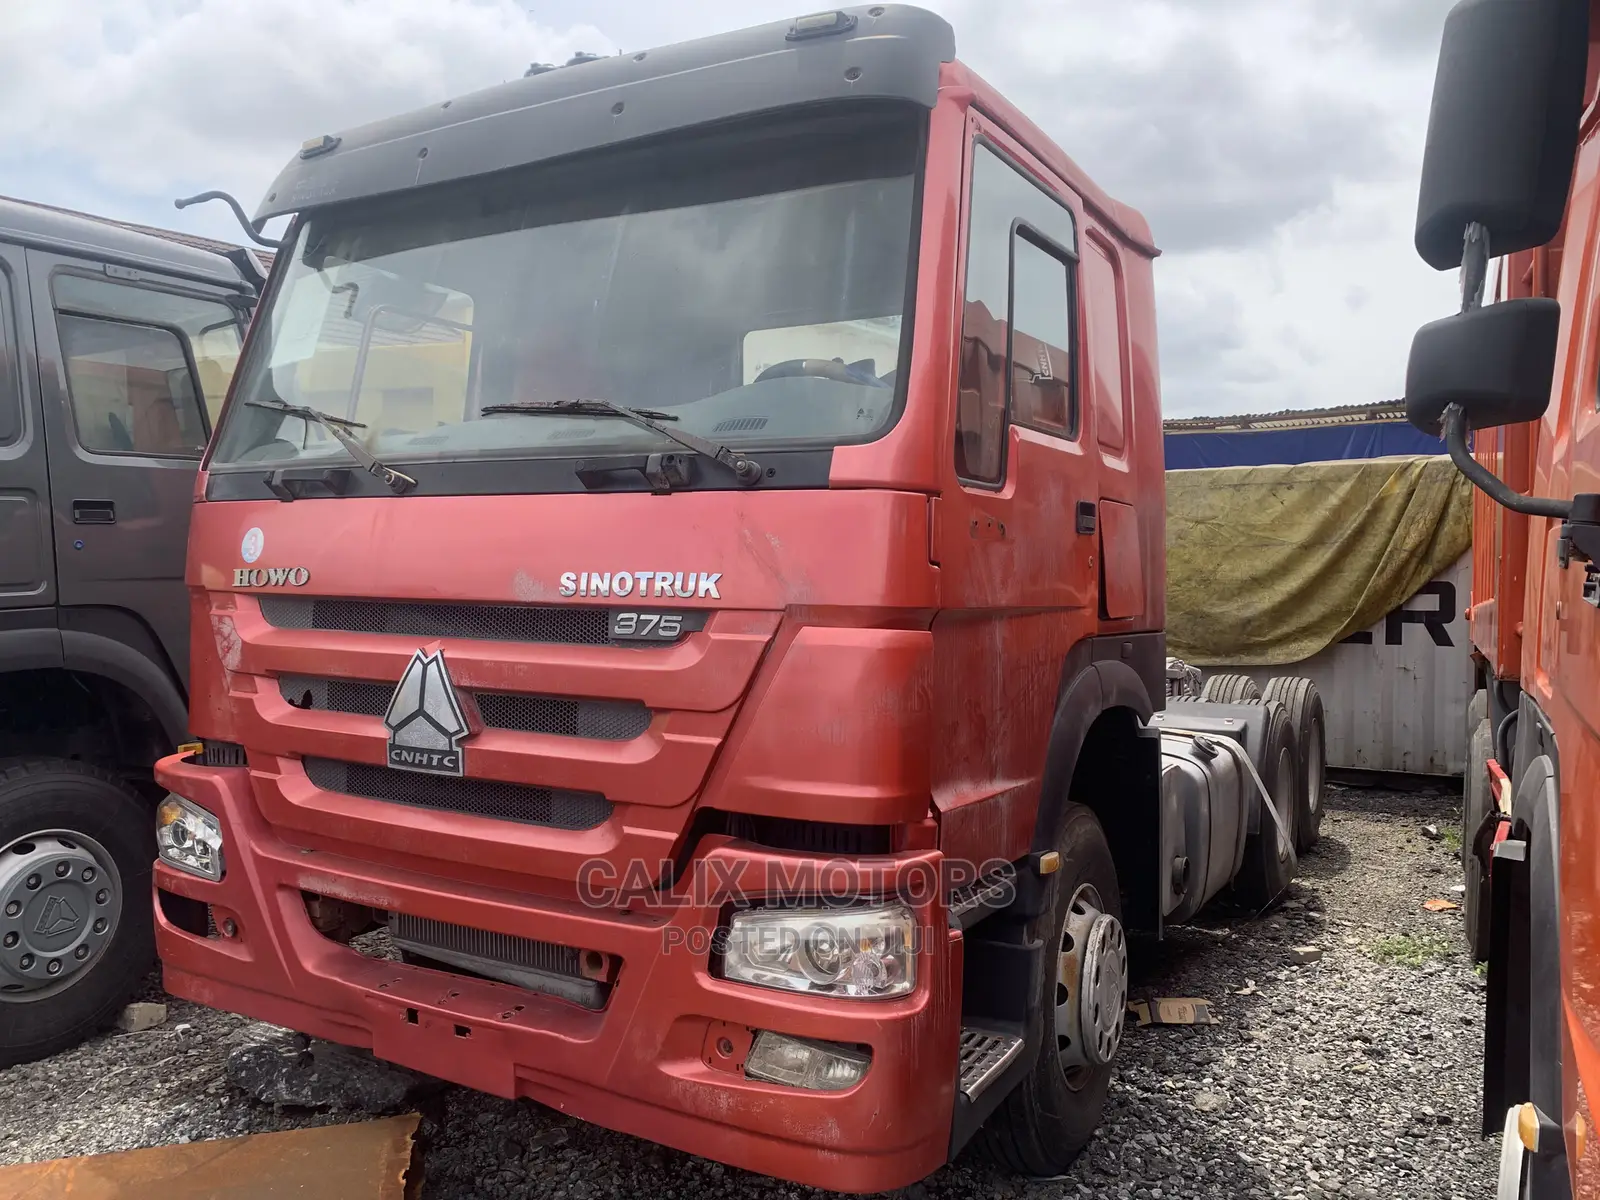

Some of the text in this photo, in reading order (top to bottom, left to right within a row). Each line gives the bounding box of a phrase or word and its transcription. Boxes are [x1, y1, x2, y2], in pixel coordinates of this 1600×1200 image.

[232, 566, 310, 587] HOWO
[559, 571, 723, 600] SINOTRUK
[613, 612, 683, 638] 375
[390, 748, 456, 768] CNHTC
